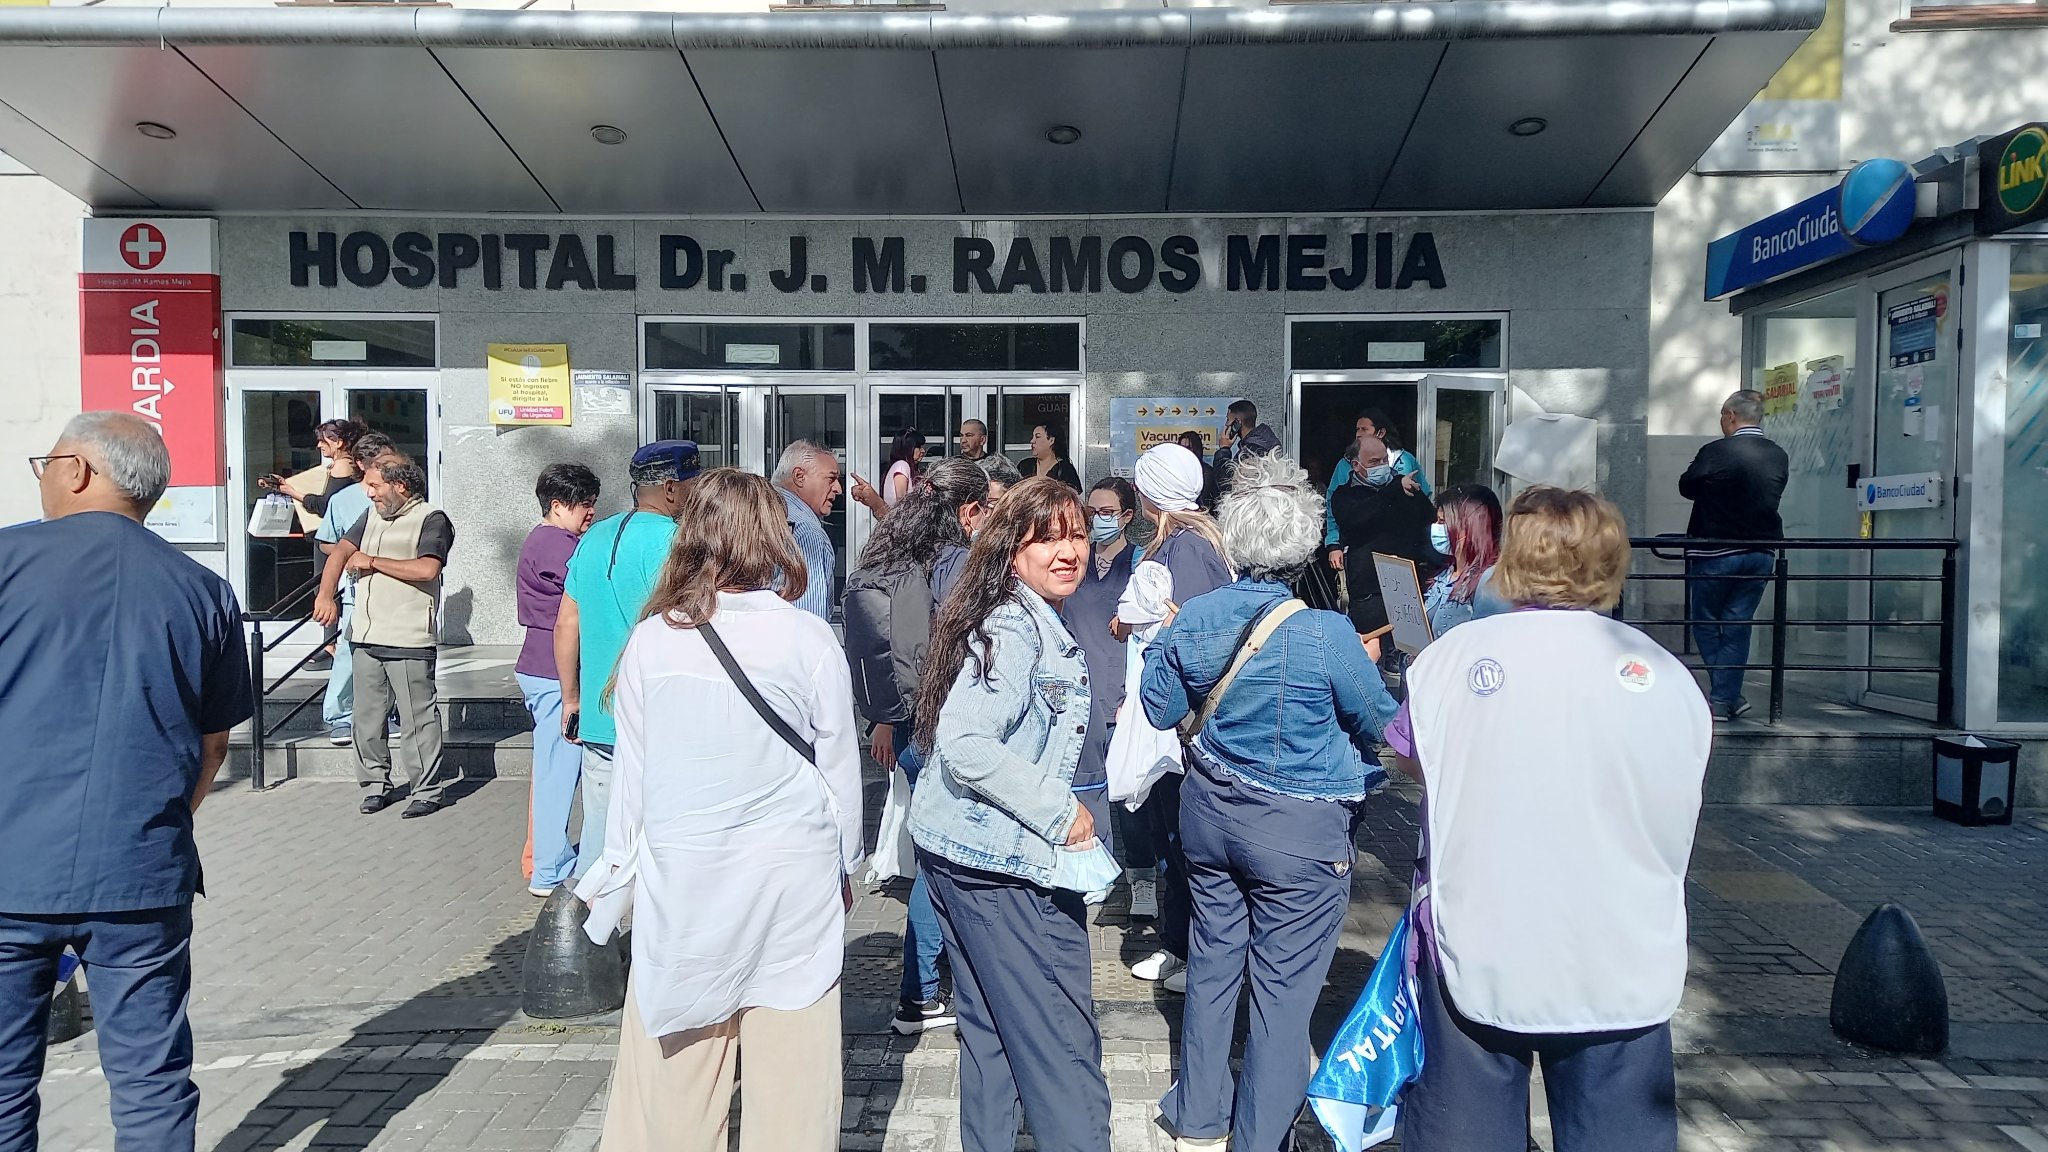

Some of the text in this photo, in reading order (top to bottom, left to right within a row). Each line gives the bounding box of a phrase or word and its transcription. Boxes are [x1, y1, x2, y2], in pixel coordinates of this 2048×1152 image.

[289, 231, 1448, 294] HOSPITAL Dr. J. M. RAMOS MEJIA
[1752, 205, 1839, 263] BancoCiuda
[130, 299, 163, 437] ARDIA
[1037, 403, 1069, 413] GUAR
[1877, 482, 1926, 498] BancoCiudad
